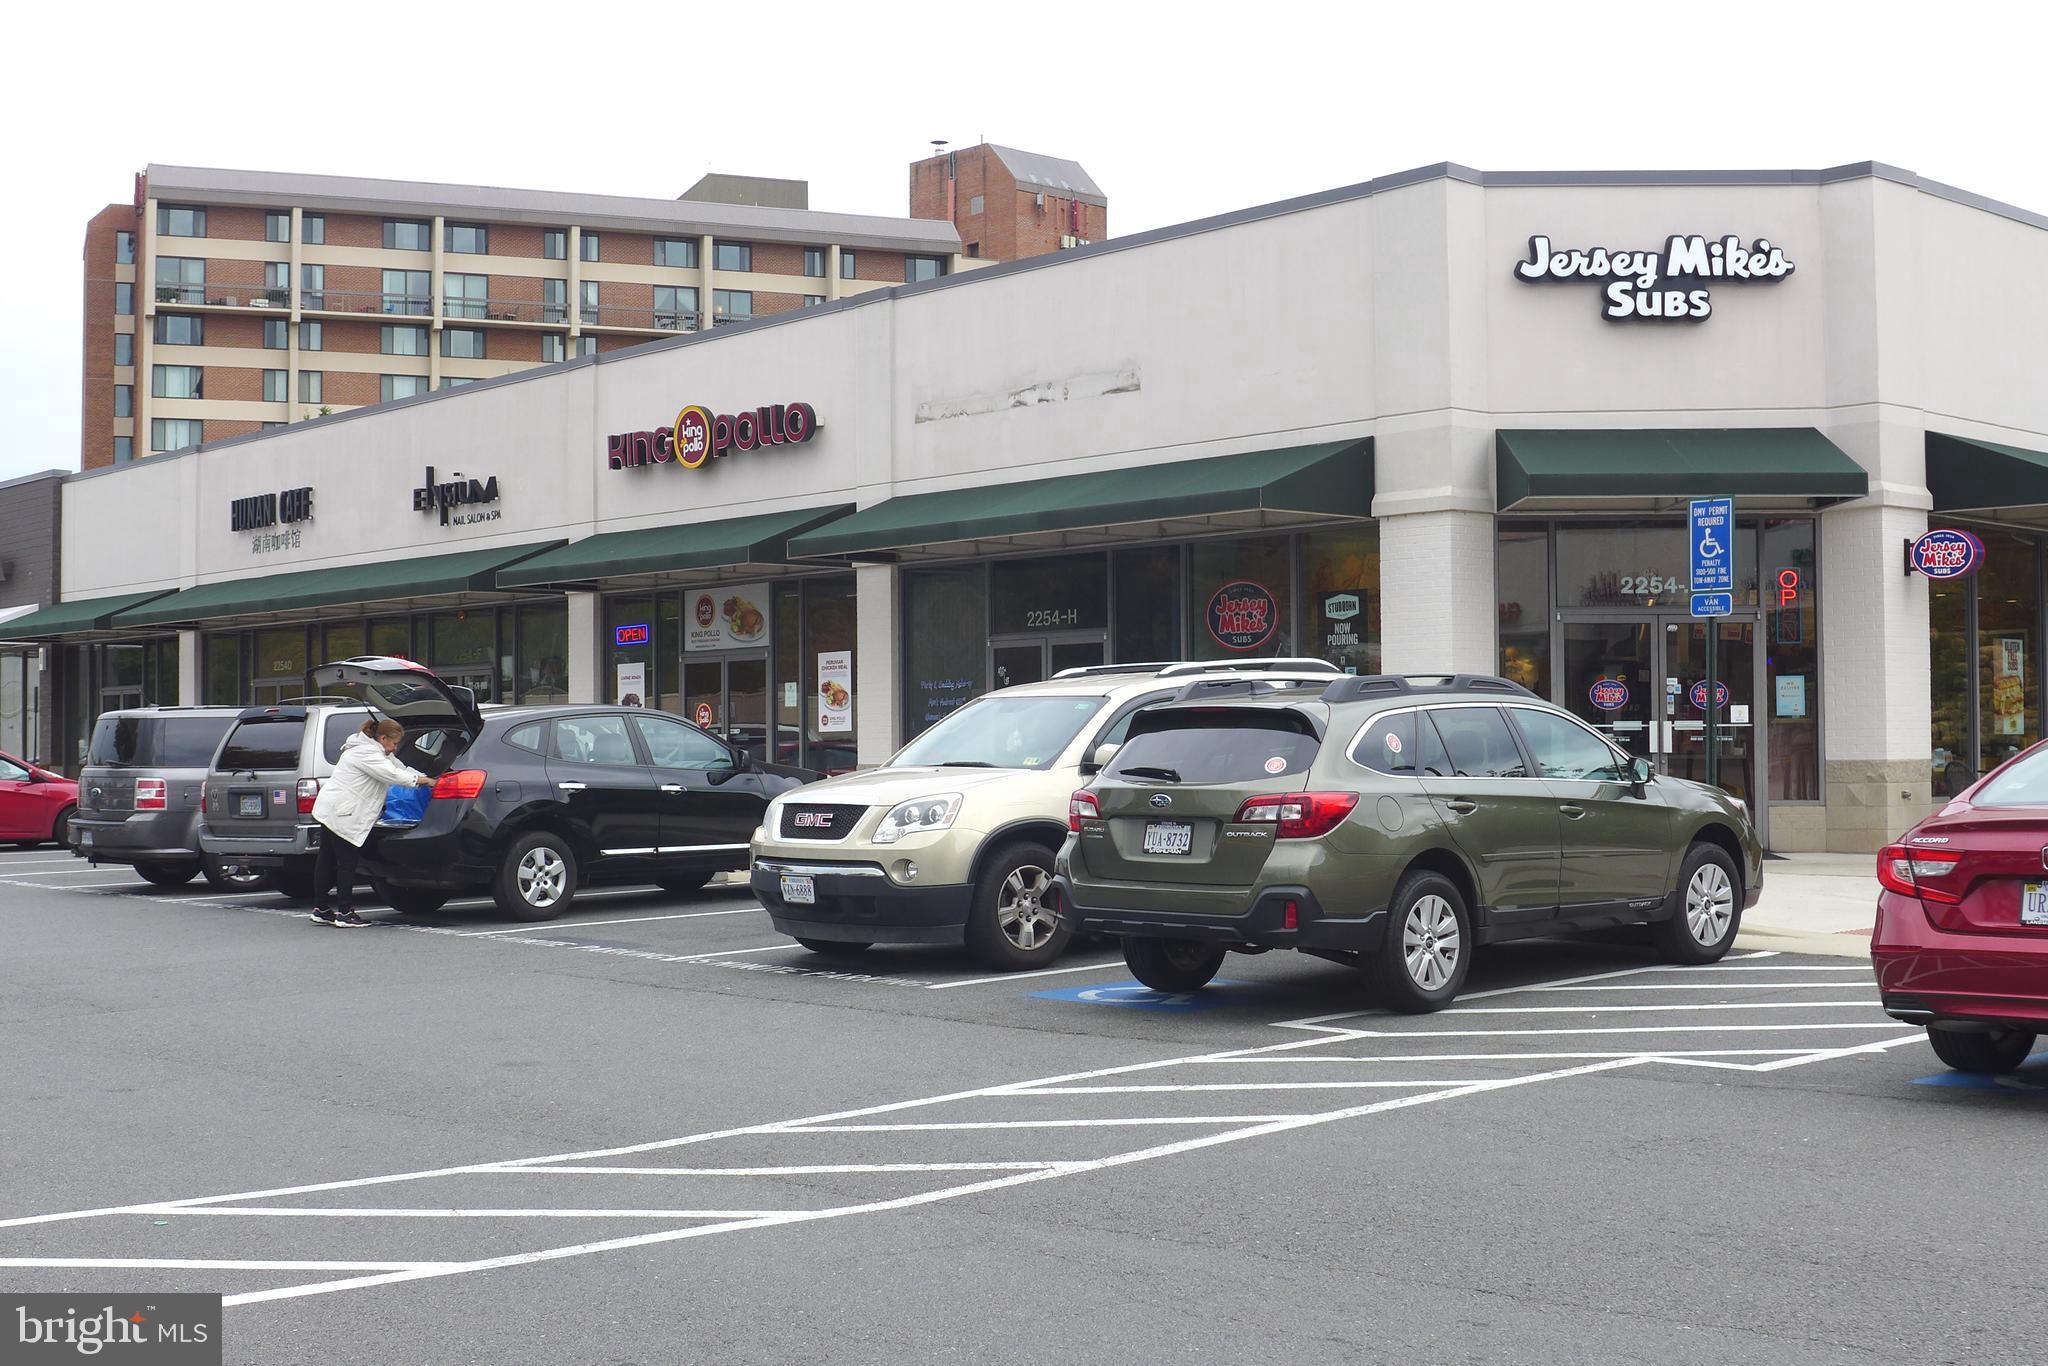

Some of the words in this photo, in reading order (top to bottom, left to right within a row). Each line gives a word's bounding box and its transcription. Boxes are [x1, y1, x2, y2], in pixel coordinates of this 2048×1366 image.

[1516, 236, 1659, 289] Jersey
[1665, 236, 1794, 280] Mike's
[682, 424, 703, 439] king
[683, 438, 703, 457] pollo
[231, 493, 276, 531] HUNAN
[279, 487, 313, 523] CAFE
[1693, 507, 1706, 517] DMV
[1708, 505, 1728, 516] PERMIT
[453, 514, 466, 526] NAIL
[467, 512, 485, 524] SALON
[491, 509, 501, 521] SPA
[1697, 516, 1724, 527] REQUIRED
[252, 529, 301, 554] 湖南咖啡馆
[1920, 538, 1967, 557] Jersey
[1702, 559, 1720, 567] PENALTY
[1922, 552, 1965, 568] Mike's
[1718, 575, 1730, 583] ZONE
[1215, 594, 1268, 618] Jersey
[1328, 601, 1357, 613] STUBBORN
[1704, 598, 1719, 606] VAN
[1027, 609, 1077, 626] 2254-H
[1219, 612, 1267, 634] Mike's
[618, 628, 645, 642] OPEN
[1334, 622, 1351, 634] NOW
[1232, 635, 1252, 643] SUBS
[1327, 633, 1359, 646] POURING
[1594, 685, 1623, 696] Jersey
[795, 813, 833, 827] GMC
[1146, 832, 1189, 847] YUA-8732
